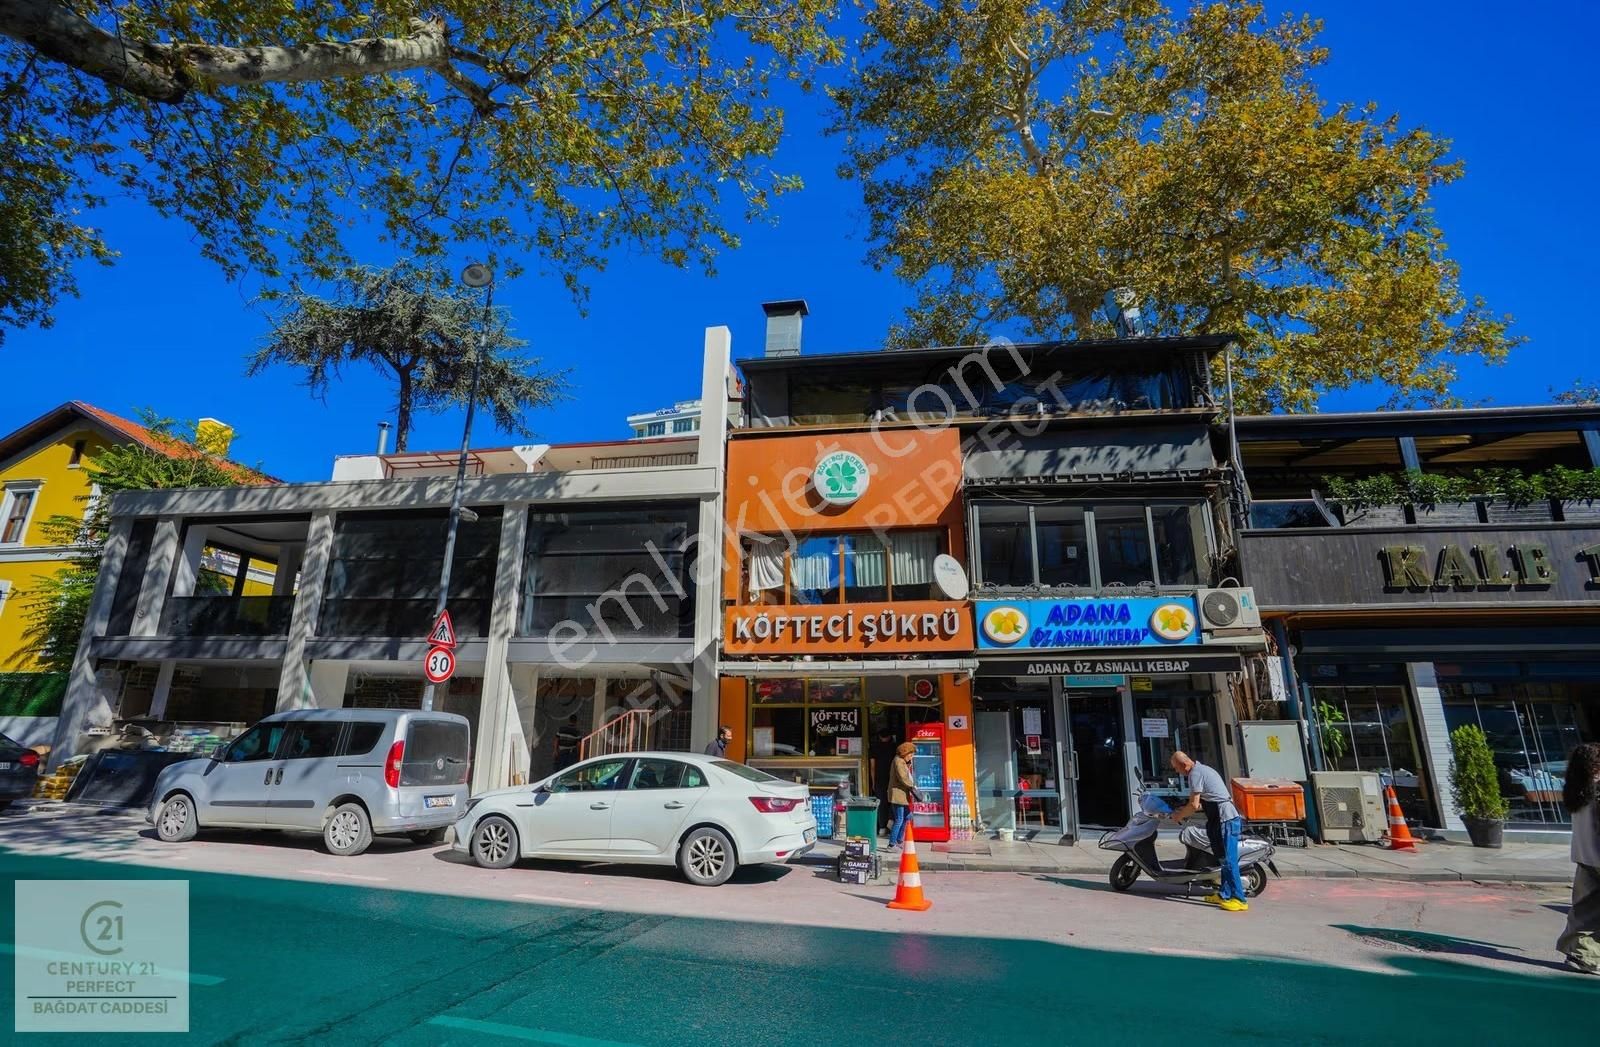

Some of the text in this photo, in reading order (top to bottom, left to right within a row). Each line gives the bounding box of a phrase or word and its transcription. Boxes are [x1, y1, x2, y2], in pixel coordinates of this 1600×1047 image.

[1379, 543, 1558, 588] KALE
[1049, 603, 1131, 624] ADANA
[735, 608, 960, 642] KÖFTECİ ŞÜKRÜ
[1033, 626, 1150, 644] ÖZ ASMALI KEBAP
[430, 655, 449, 673] 30
[1027, 660, 1190, 674] ADANA ÖZ ASMALI KEBAP
[811, 708, 858, 728] KÖFTECİ
